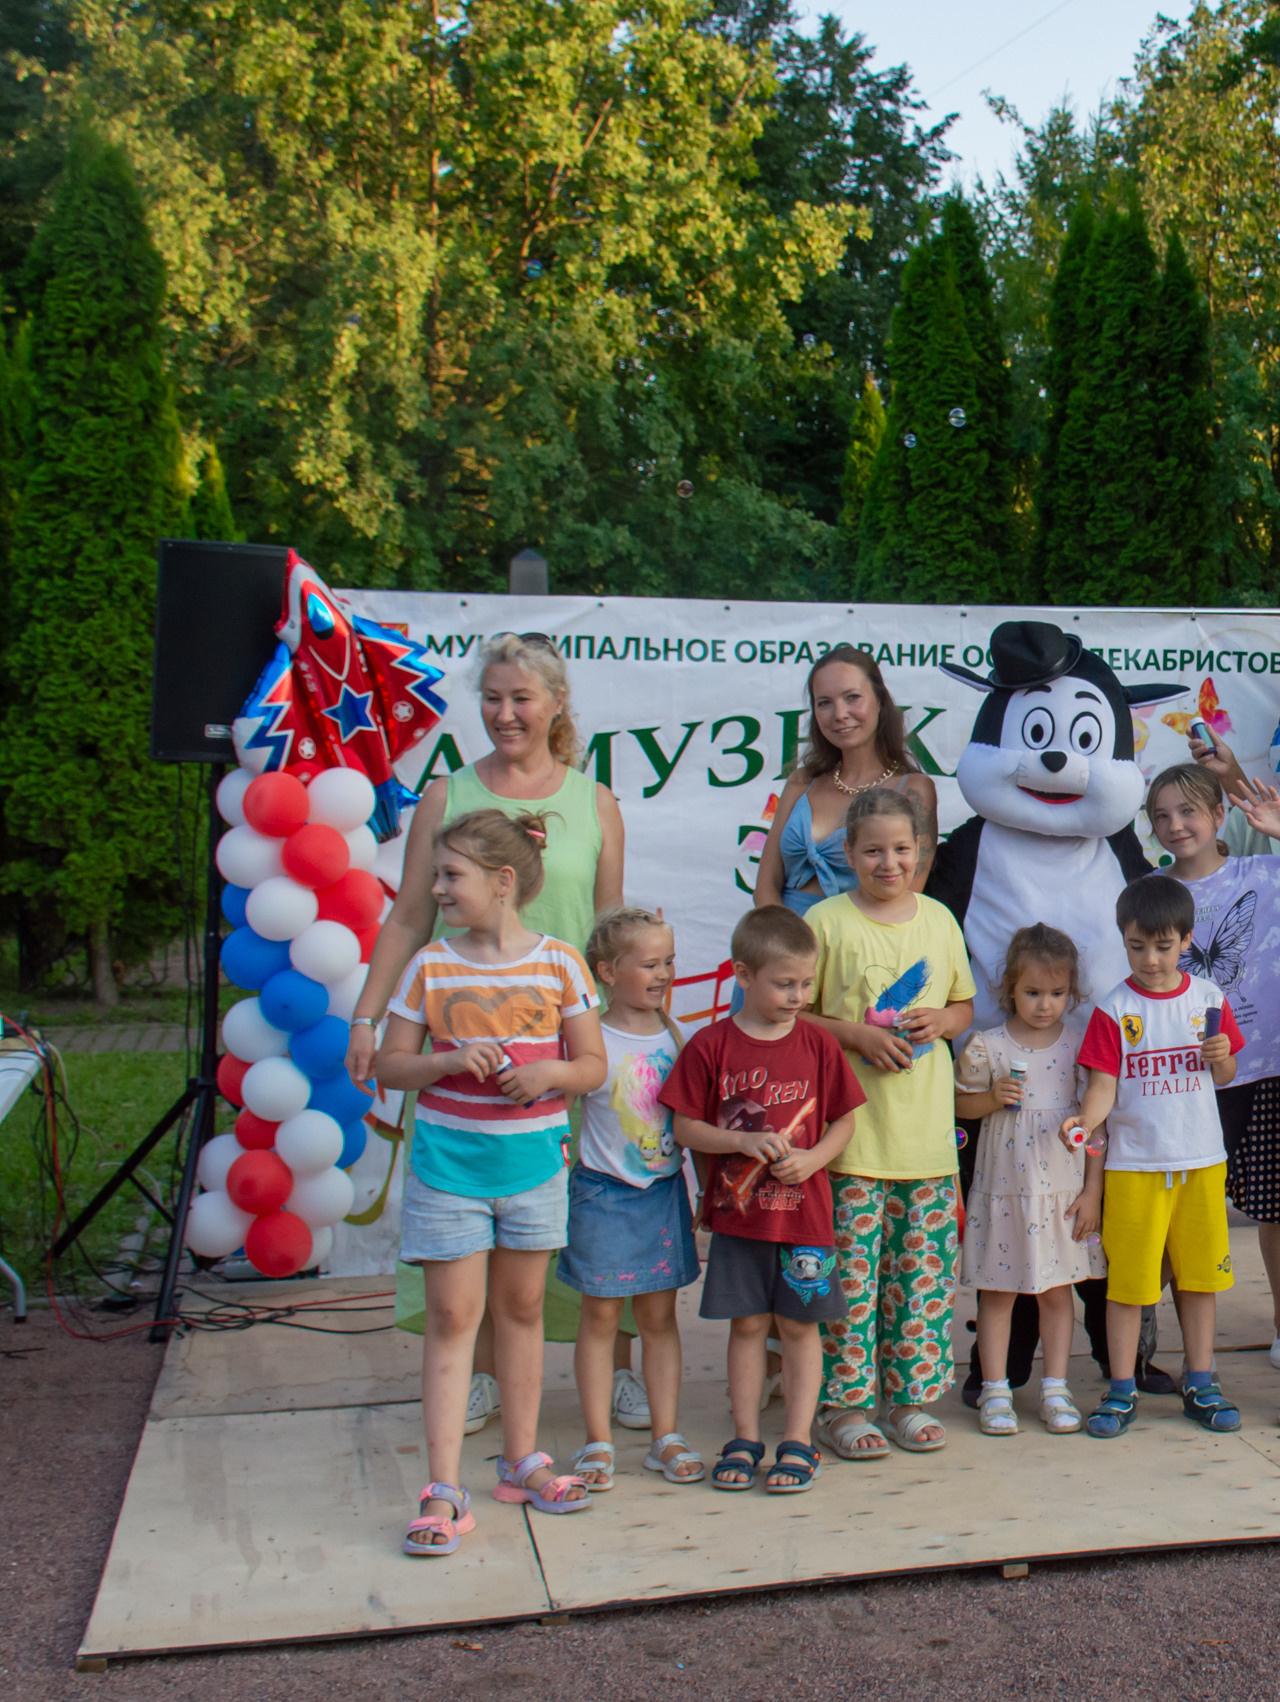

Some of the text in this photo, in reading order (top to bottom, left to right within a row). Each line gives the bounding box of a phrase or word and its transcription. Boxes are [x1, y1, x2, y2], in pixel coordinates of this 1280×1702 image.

[426, 634, 727, 664] МУИПАЛЬНОЕ
[734, 639, 955, 668] ОБРАЗАНИЕ
[720, 1065, 768, 1101] KYLO
[763, 1079, 809, 1107] REN
[1141, 1076, 1202, 1097] ITALIA
